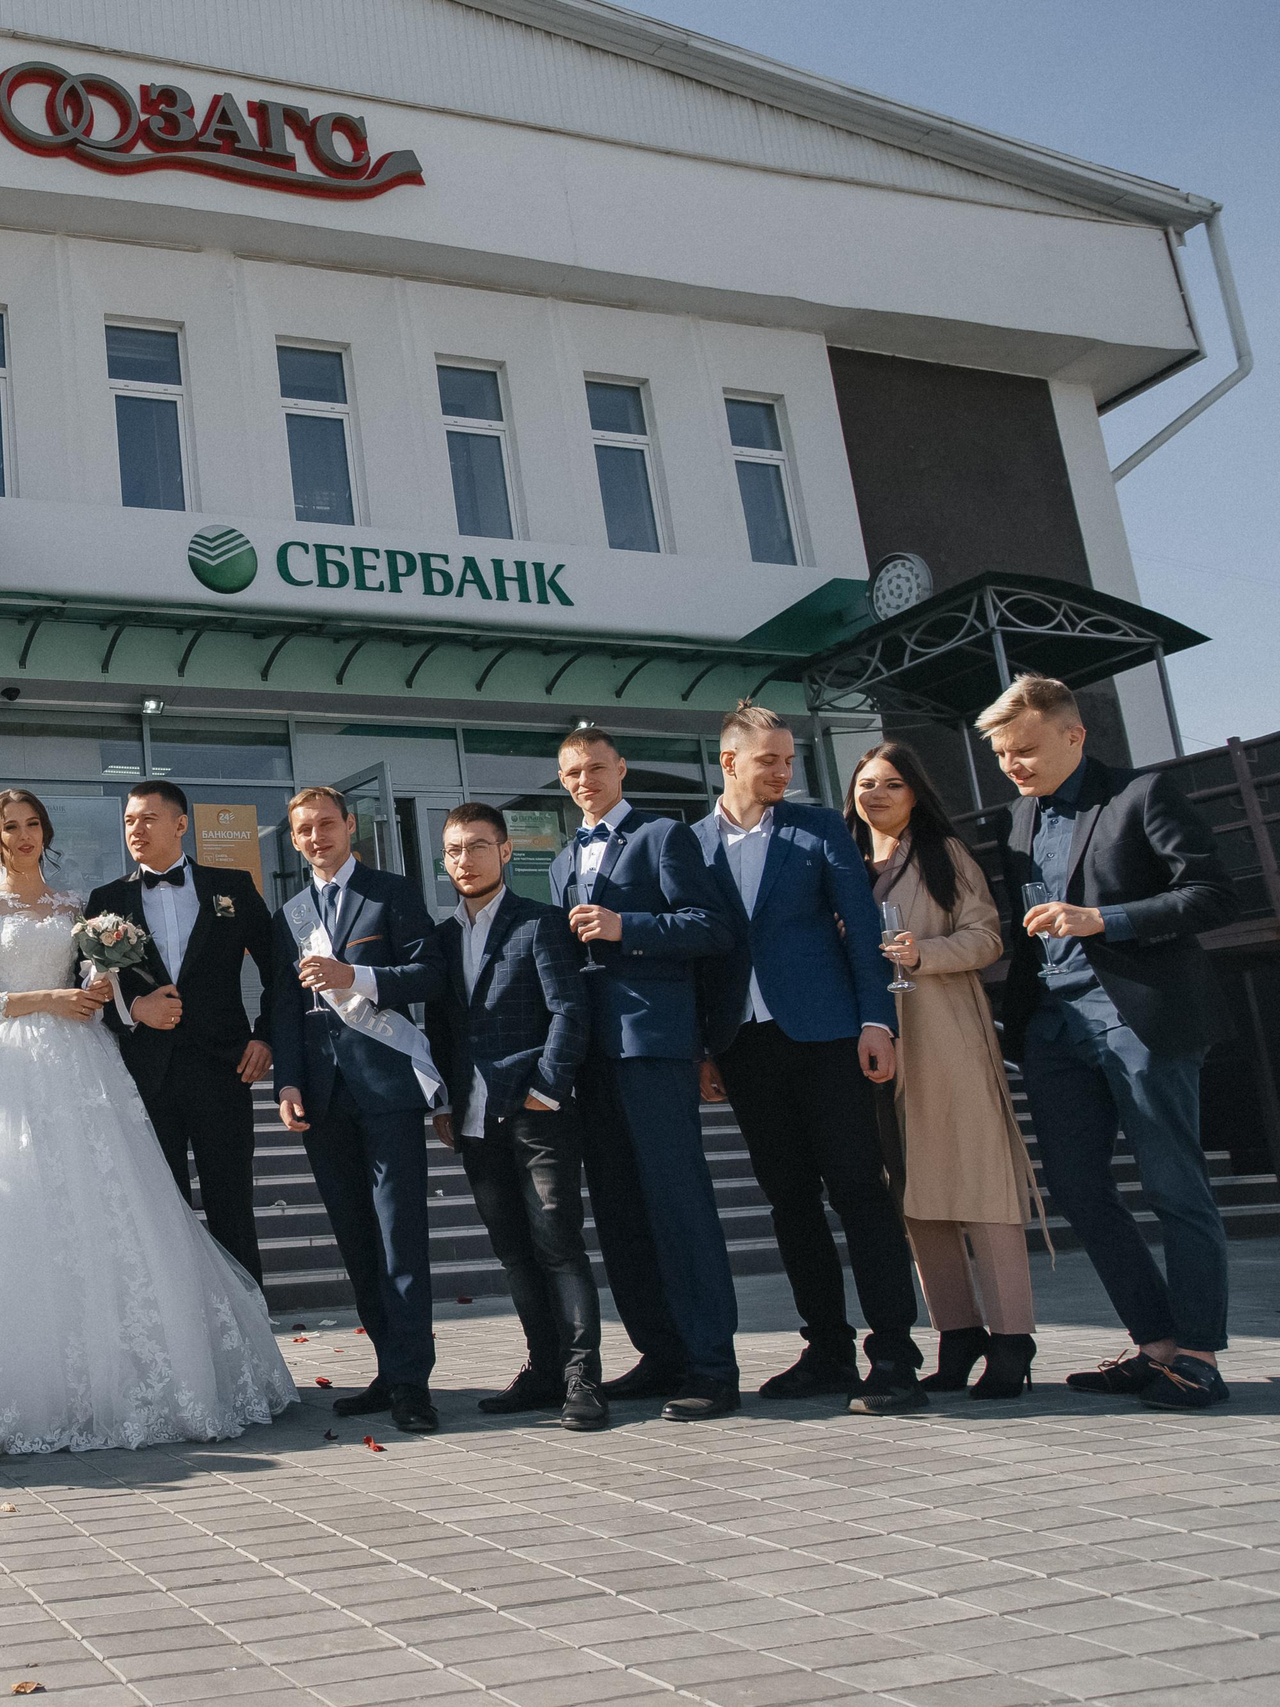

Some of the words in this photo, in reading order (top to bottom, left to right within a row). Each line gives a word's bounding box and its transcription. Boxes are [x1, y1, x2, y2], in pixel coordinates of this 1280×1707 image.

[140, 83, 370, 177] ЗАГС
[276, 541, 575, 607] СБЕРБАНК
[202, 830, 252, 839] БАНКОМАТ
[219, 813, 230, 821] 24
